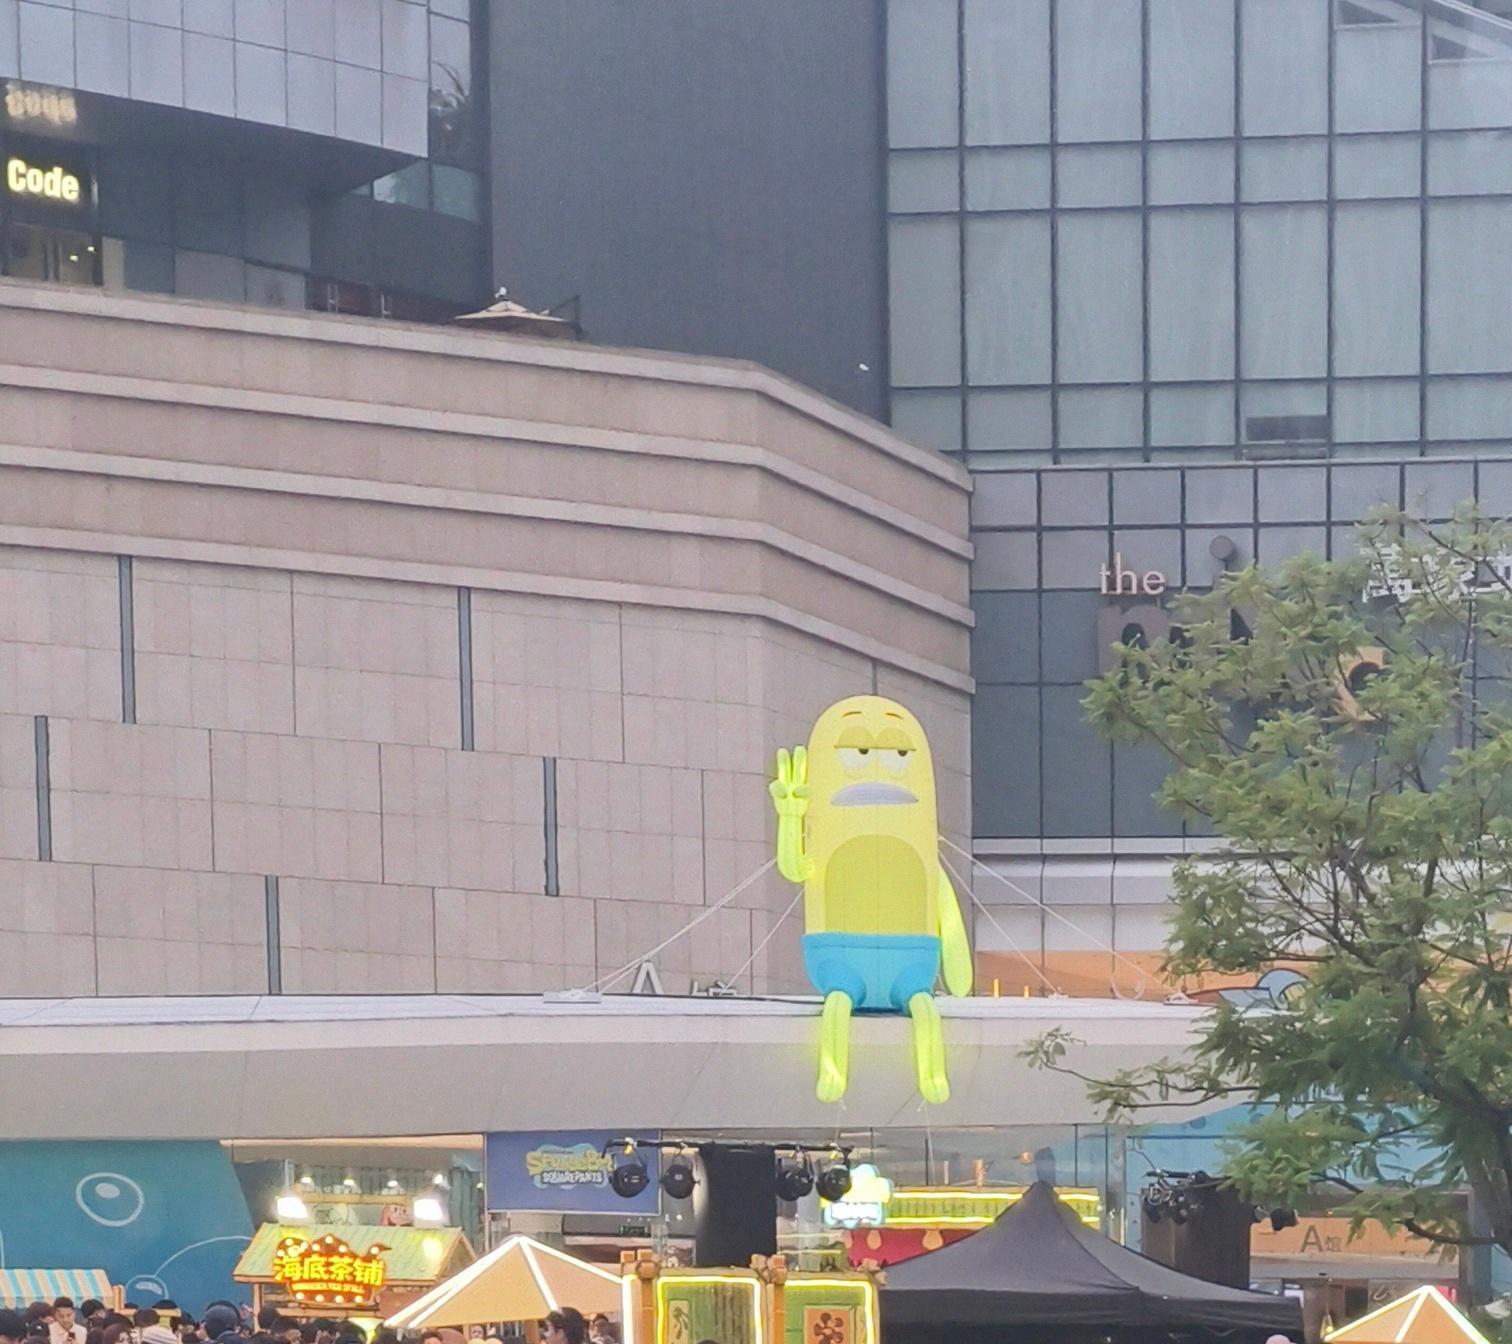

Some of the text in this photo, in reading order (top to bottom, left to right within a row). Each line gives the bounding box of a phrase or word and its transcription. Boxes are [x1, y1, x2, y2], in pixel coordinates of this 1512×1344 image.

[7, 158, 80, 201] Code
[1100, 552, 1166, 596] the
[273, 1253, 385, 1286] 海底茶铺
